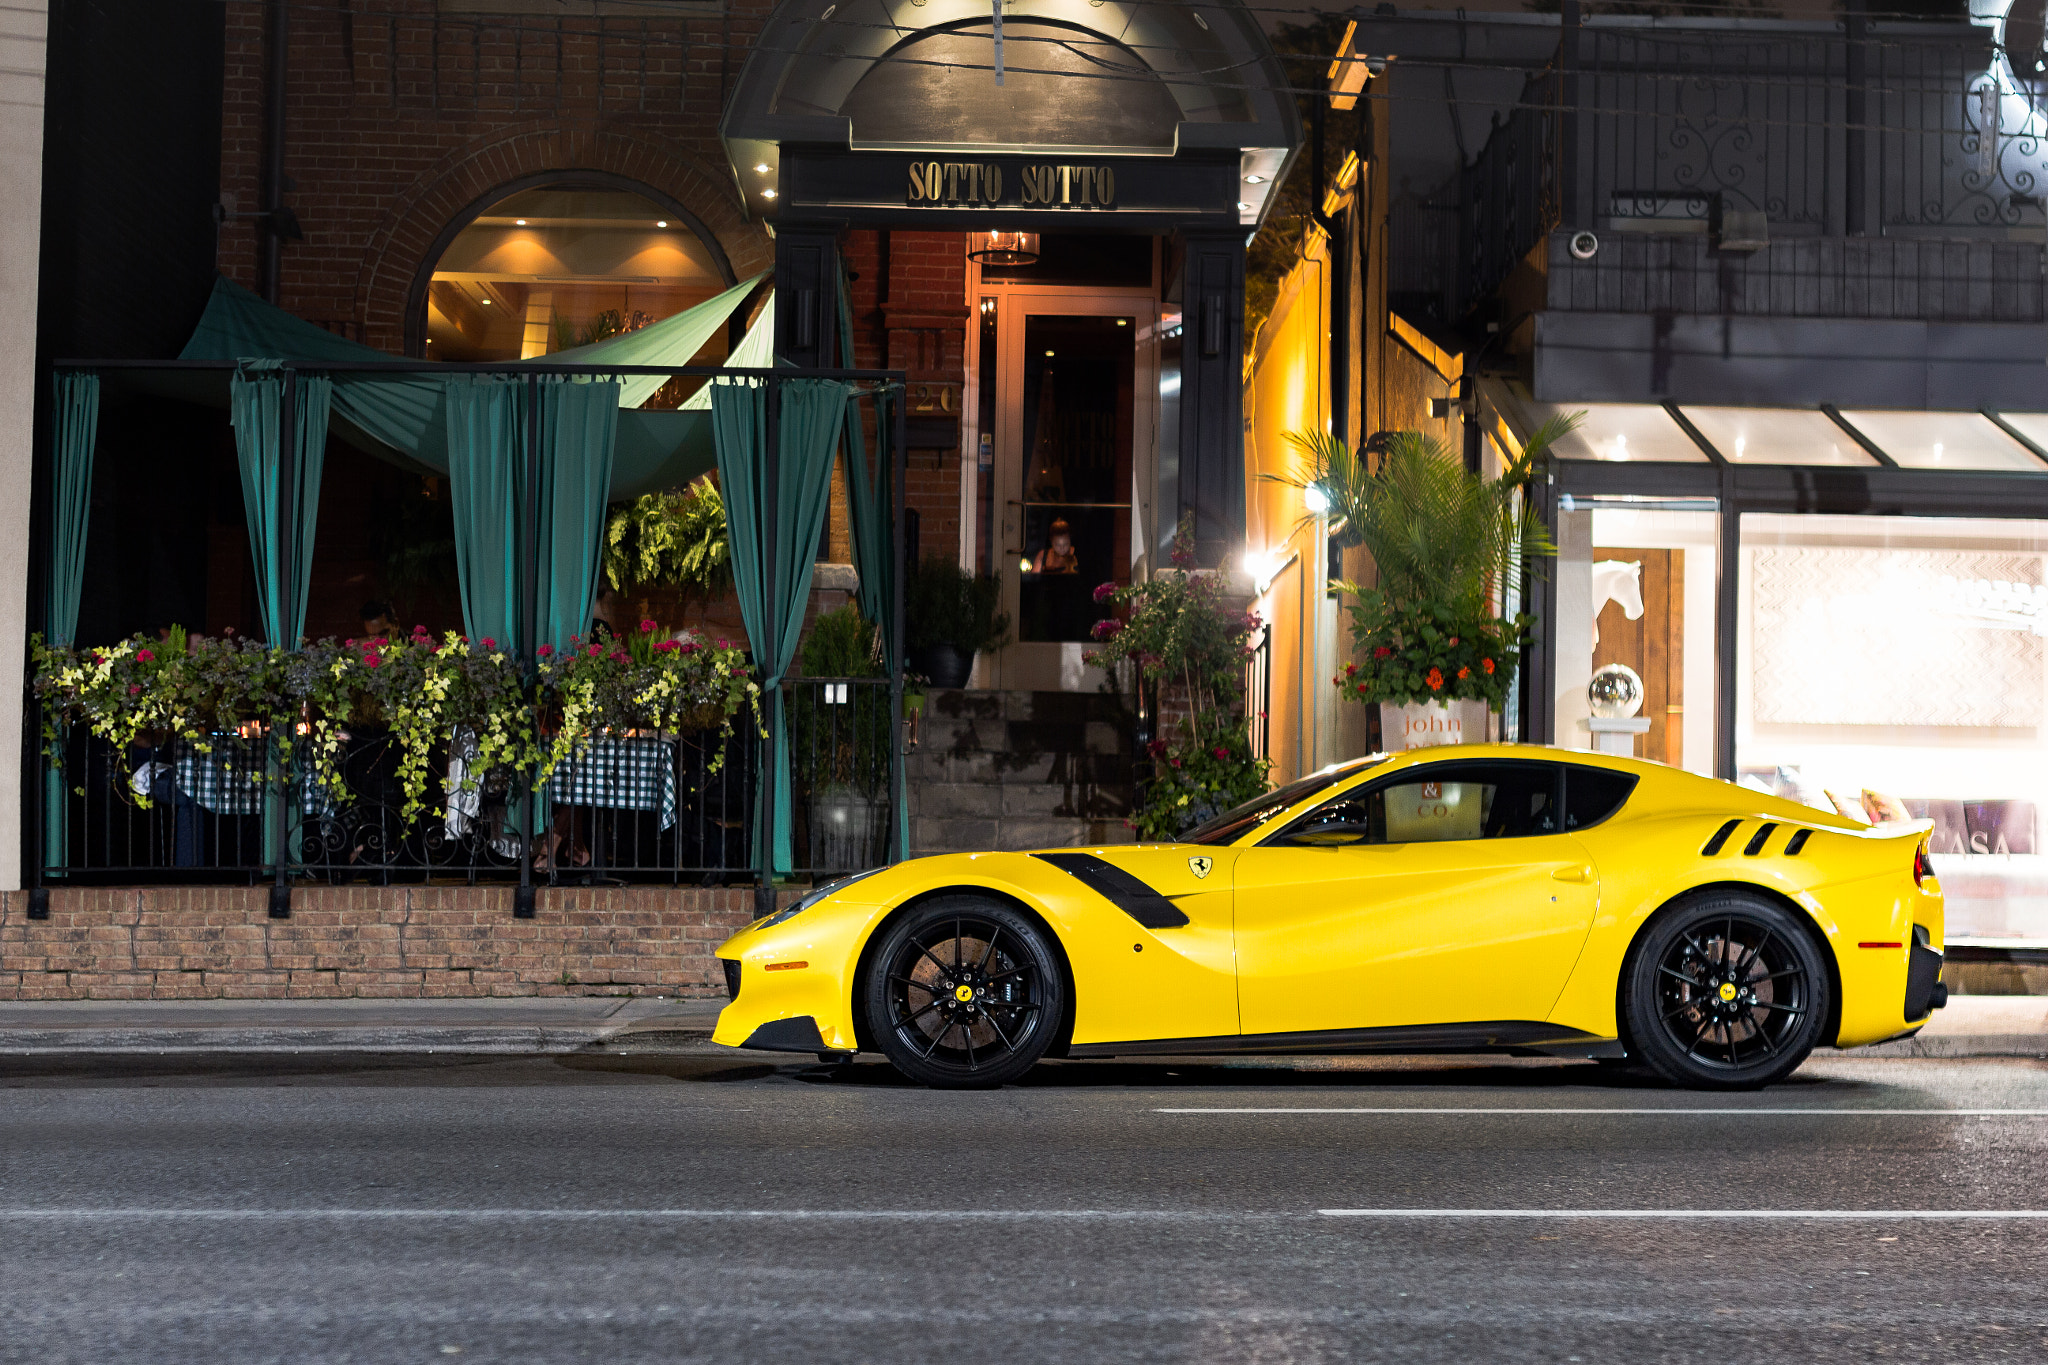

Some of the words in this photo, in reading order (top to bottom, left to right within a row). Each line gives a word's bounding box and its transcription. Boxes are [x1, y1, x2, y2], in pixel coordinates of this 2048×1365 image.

[908, 161, 1002, 202] SOTTO
[1021, 164, 1115, 204] SOTTO
[1402, 715, 1461, 738] john
[1424, 781, 1438, 798] &
[1930, 830, 2011, 861] CASA
